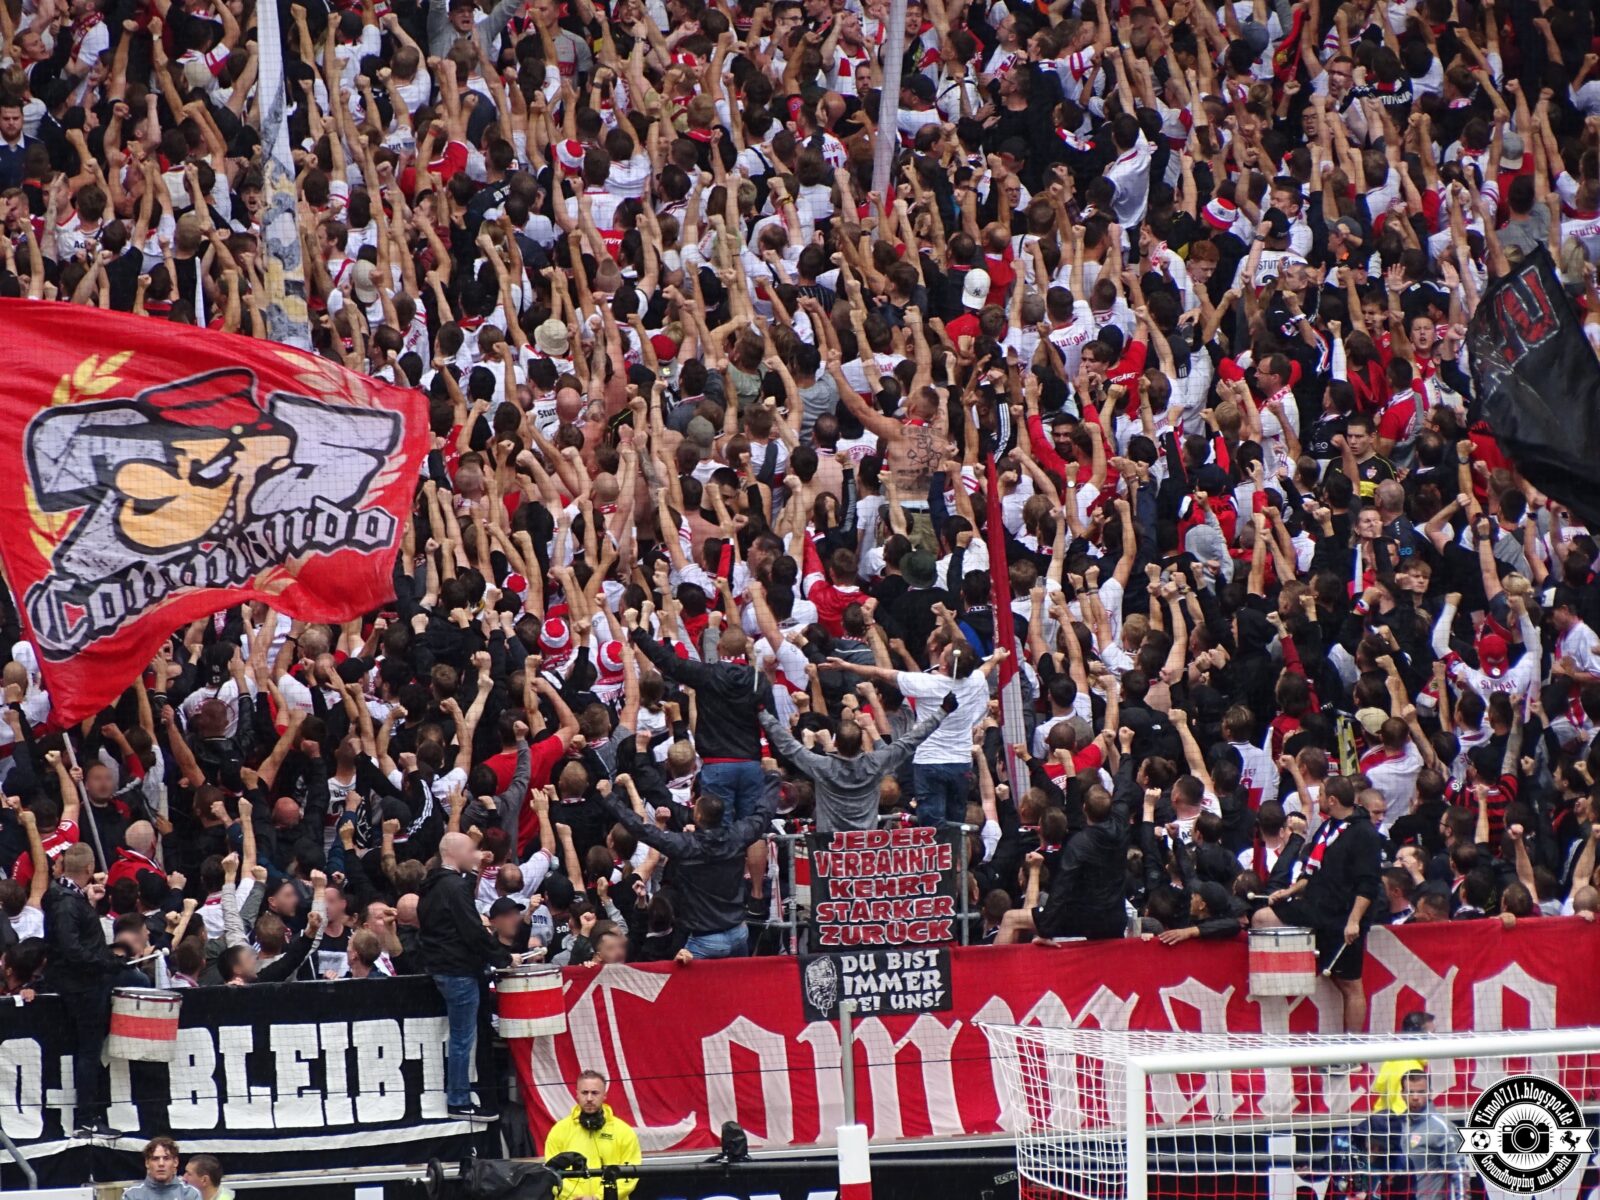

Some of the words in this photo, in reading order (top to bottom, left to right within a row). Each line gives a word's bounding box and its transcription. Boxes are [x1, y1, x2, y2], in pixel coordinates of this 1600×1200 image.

[829, 827, 936, 851] JEDER
[814, 843, 952, 878] VERBANNTE
[829, 873, 941, 899] KEHRT
[840, 953, 876, 973] DU
[886, 949, 939, 969] BIST
[843, 969, 943, 995] IMMER
[890, 991, 945, 1010] UNS!
[168, 1015, 480, 1130] BLEIBT
